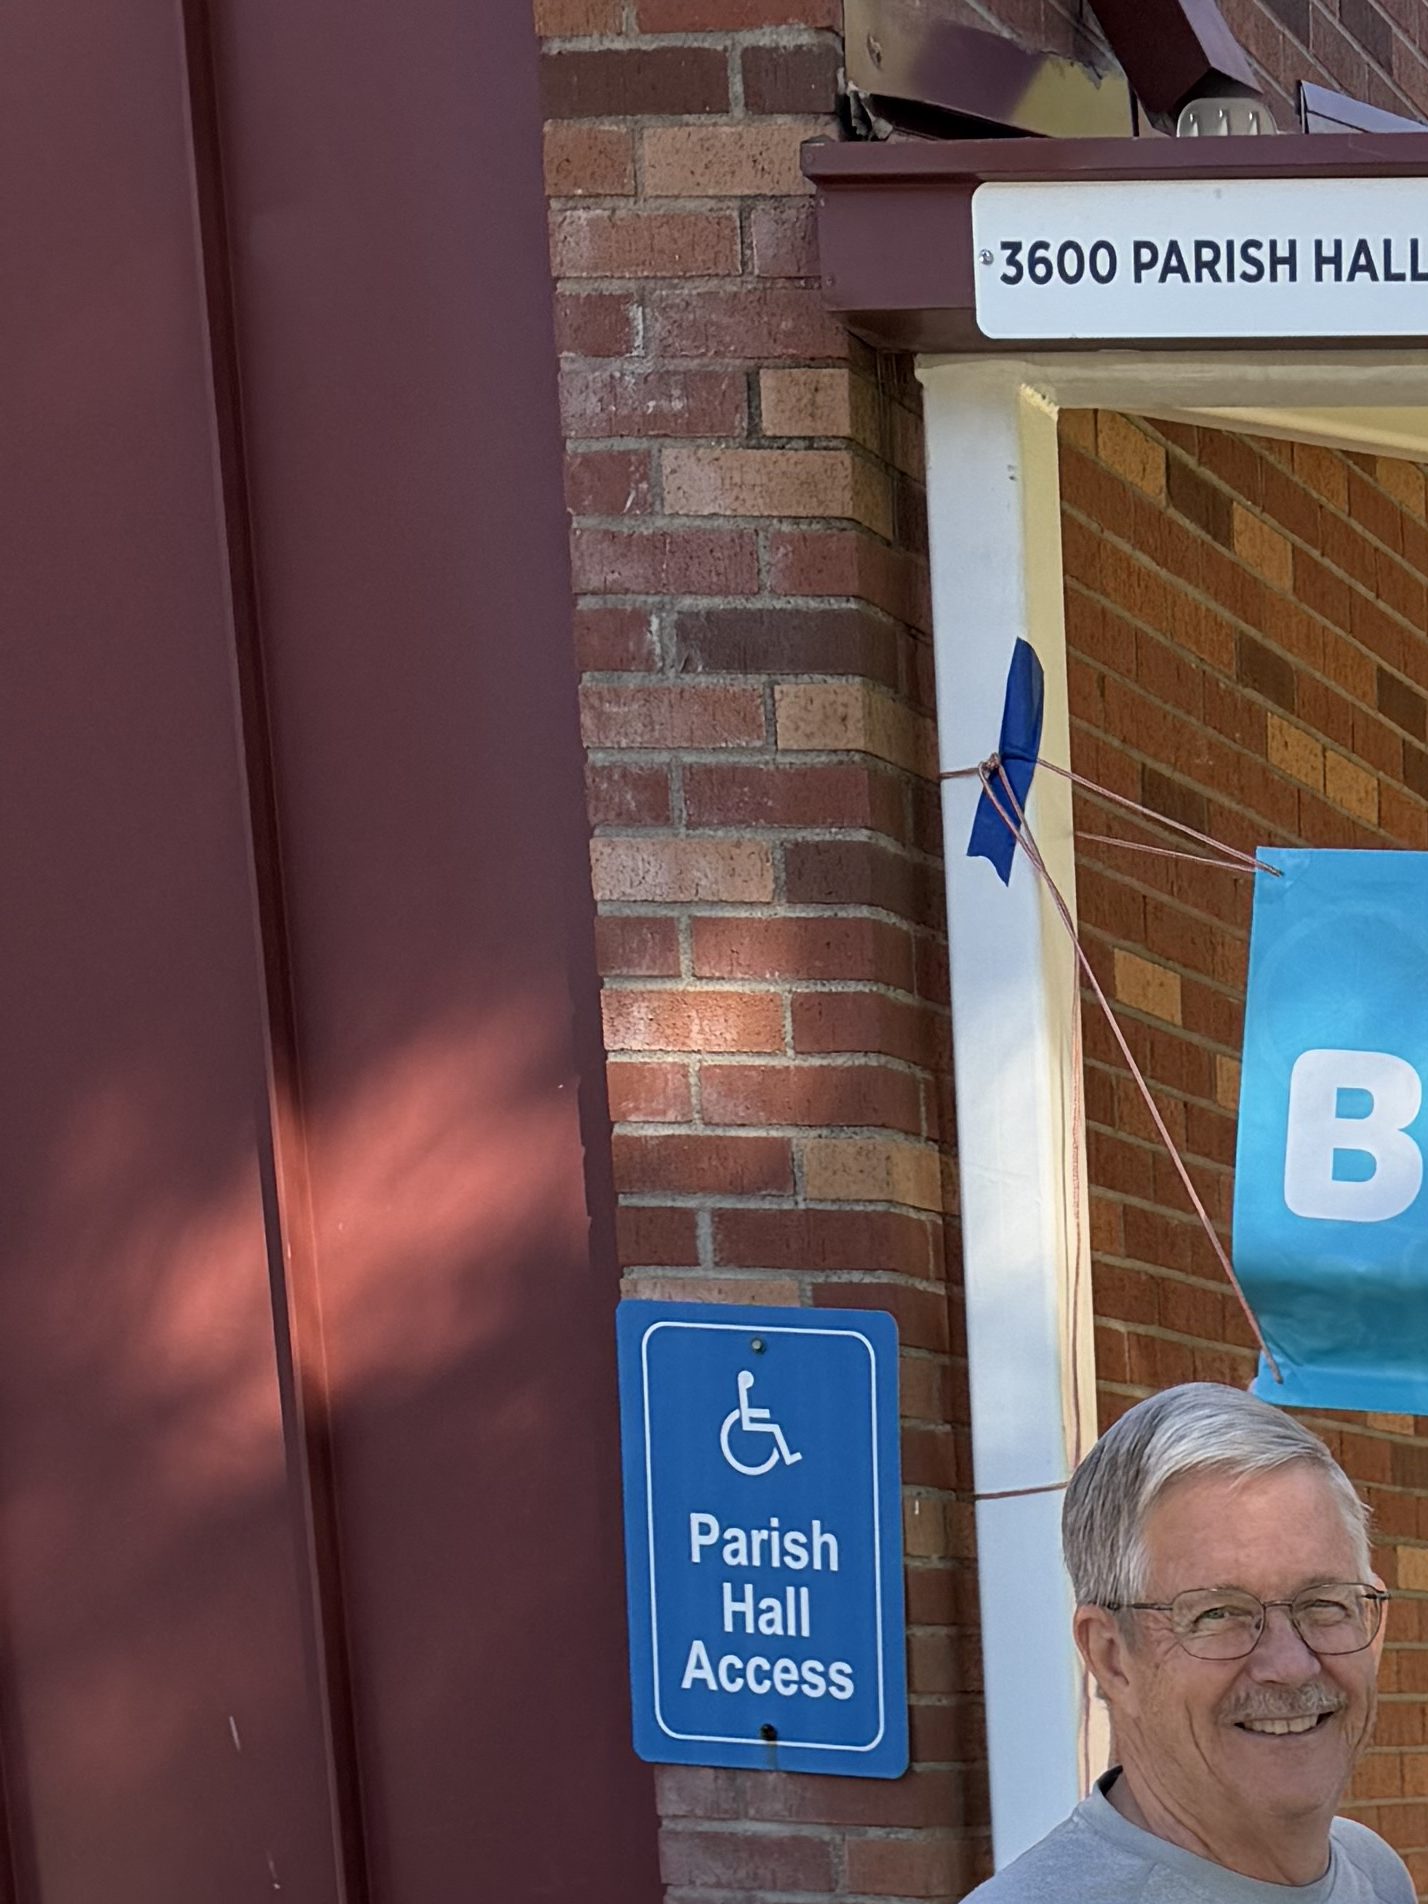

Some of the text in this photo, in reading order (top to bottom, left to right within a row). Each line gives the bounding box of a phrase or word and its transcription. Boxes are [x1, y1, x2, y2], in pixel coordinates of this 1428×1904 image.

[1000, 240, 1117, 286] 3600
[1133, 239, 1297, 284] PARISH
[689, 1512, 838, 1572] Parish
[723, 1582, 810, 1637] Hall
[681, 1640, 854, 1700] Access
